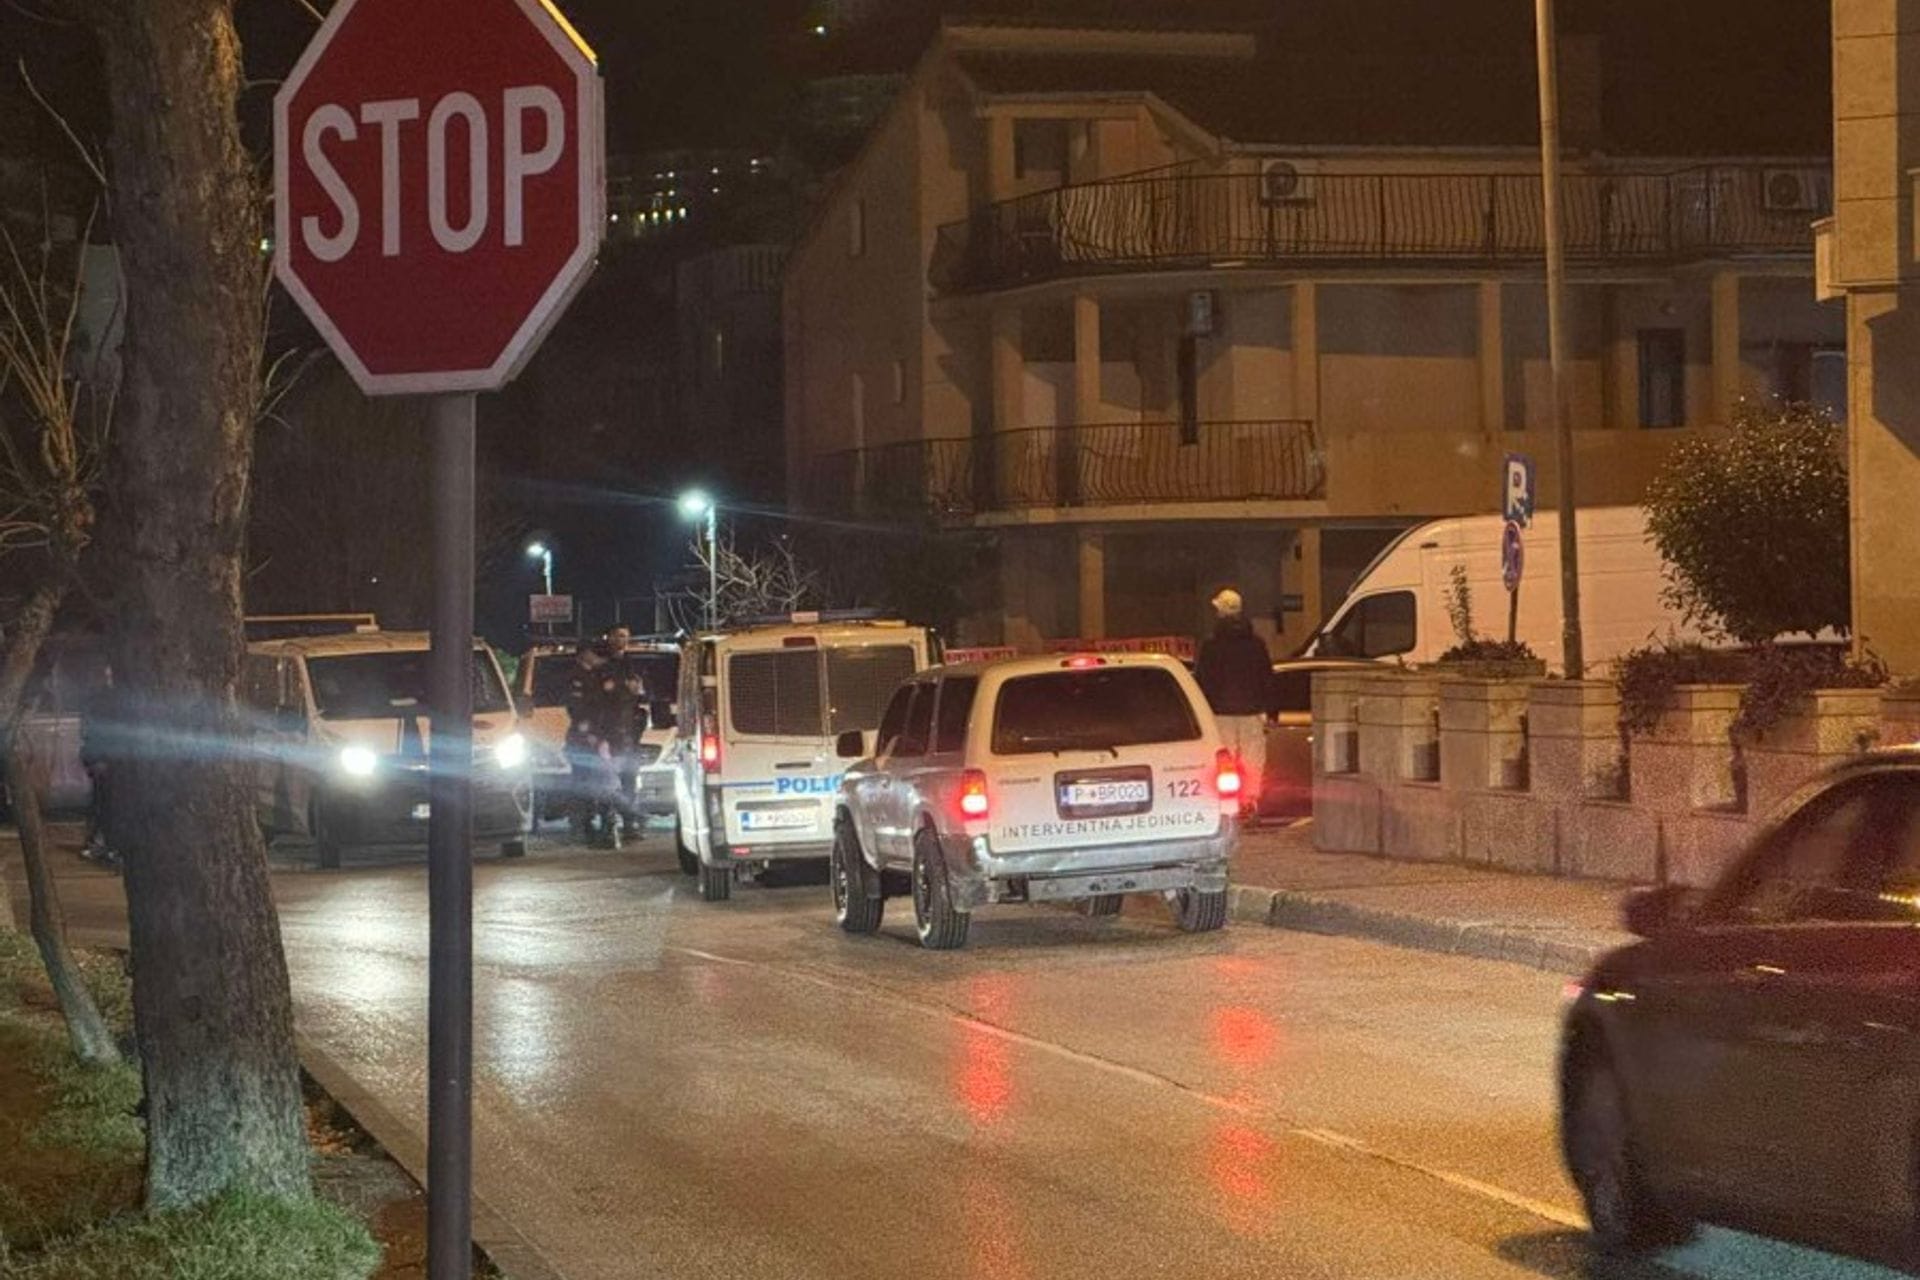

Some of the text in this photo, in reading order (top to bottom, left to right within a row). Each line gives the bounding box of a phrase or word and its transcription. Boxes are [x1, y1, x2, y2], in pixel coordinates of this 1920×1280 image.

[301, 85, 565, 262] STOP
[1166, 779, 1202, 799] 122
[1002, 812, 1206, 839] INTERVENTNA JEDINICA
